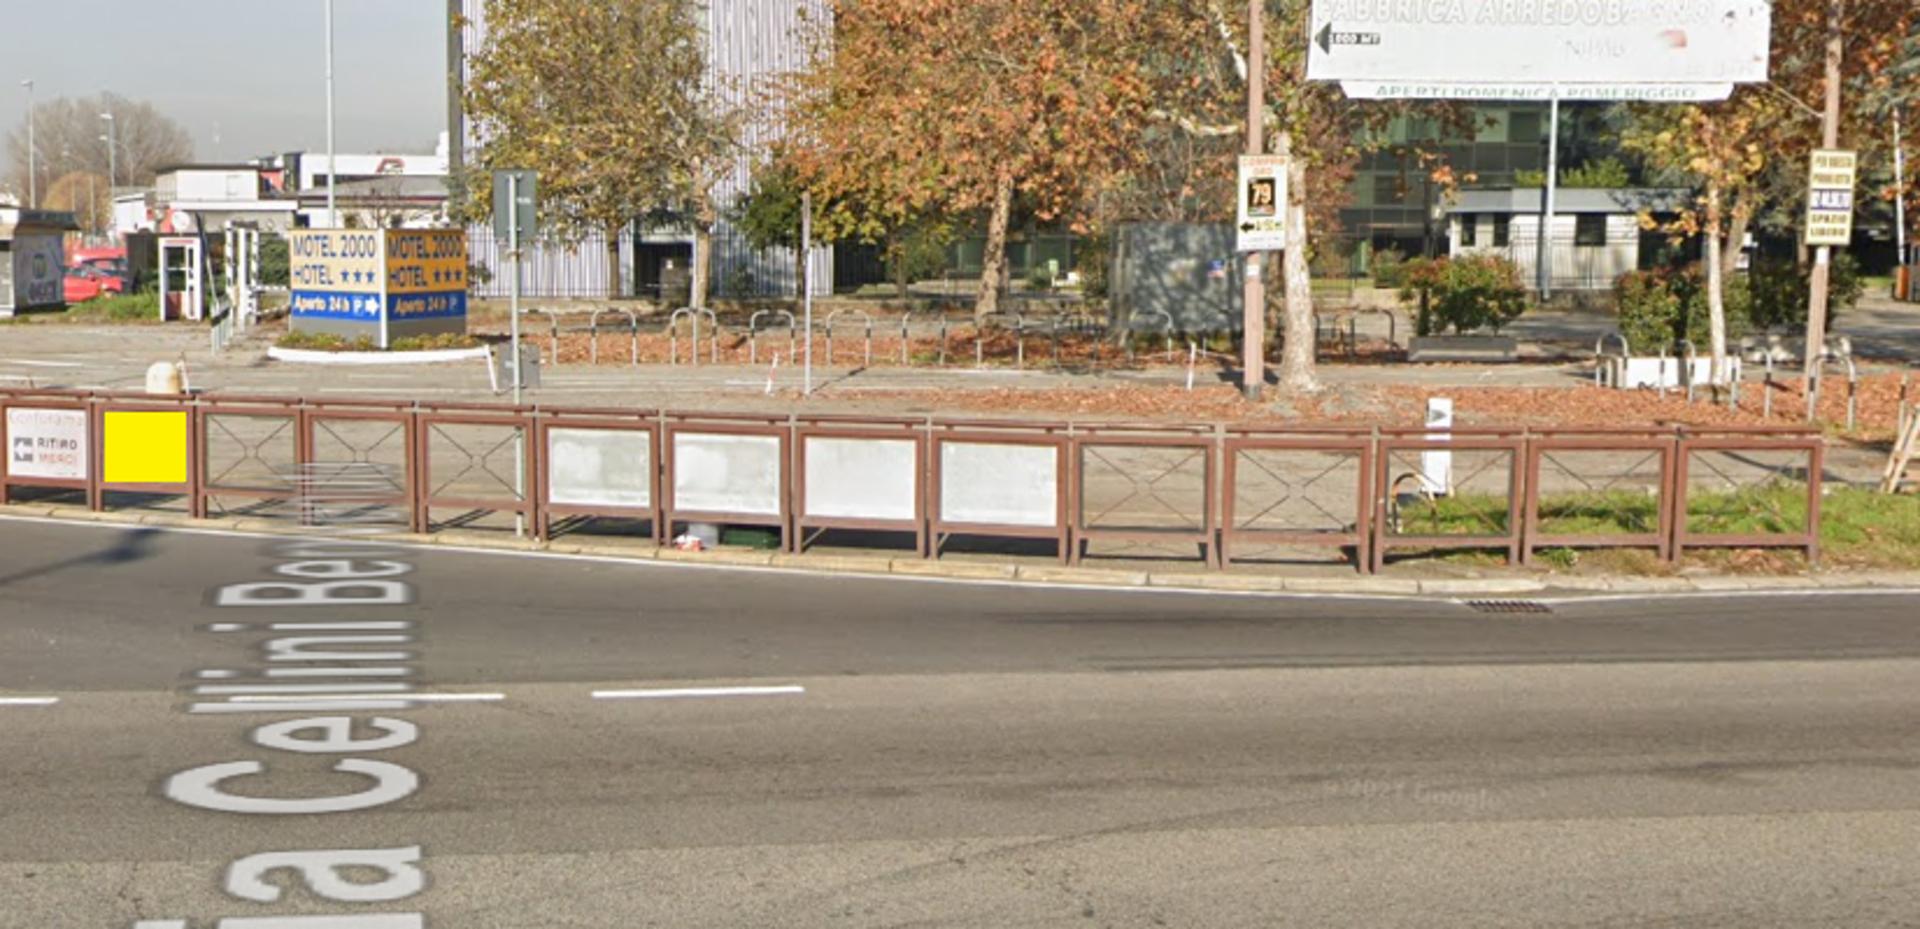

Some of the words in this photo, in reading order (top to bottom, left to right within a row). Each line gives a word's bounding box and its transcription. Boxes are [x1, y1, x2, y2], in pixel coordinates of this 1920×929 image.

[1375, 85, 1446, 97] APERTI
[1453, 86, 1559, 98] DOMENICA
[1251, 183, 1272, 205] 79
[293, 234, 336, 257] MOTEL
[340, 234, 376, 258] 2000
[388, 235, 430, 259] MOTEL
[432, 235, 463, 258] 2000
[294, 263, 334, 285] HOTEL
[389, 264, 427, 288] HOTEL
[294, 294, 326, 313] Aperto
[394, 297, 425, 315] Aperto
[37, 437, 78, 450] RITIRO
[38, 453, 77, 465] MERCI
